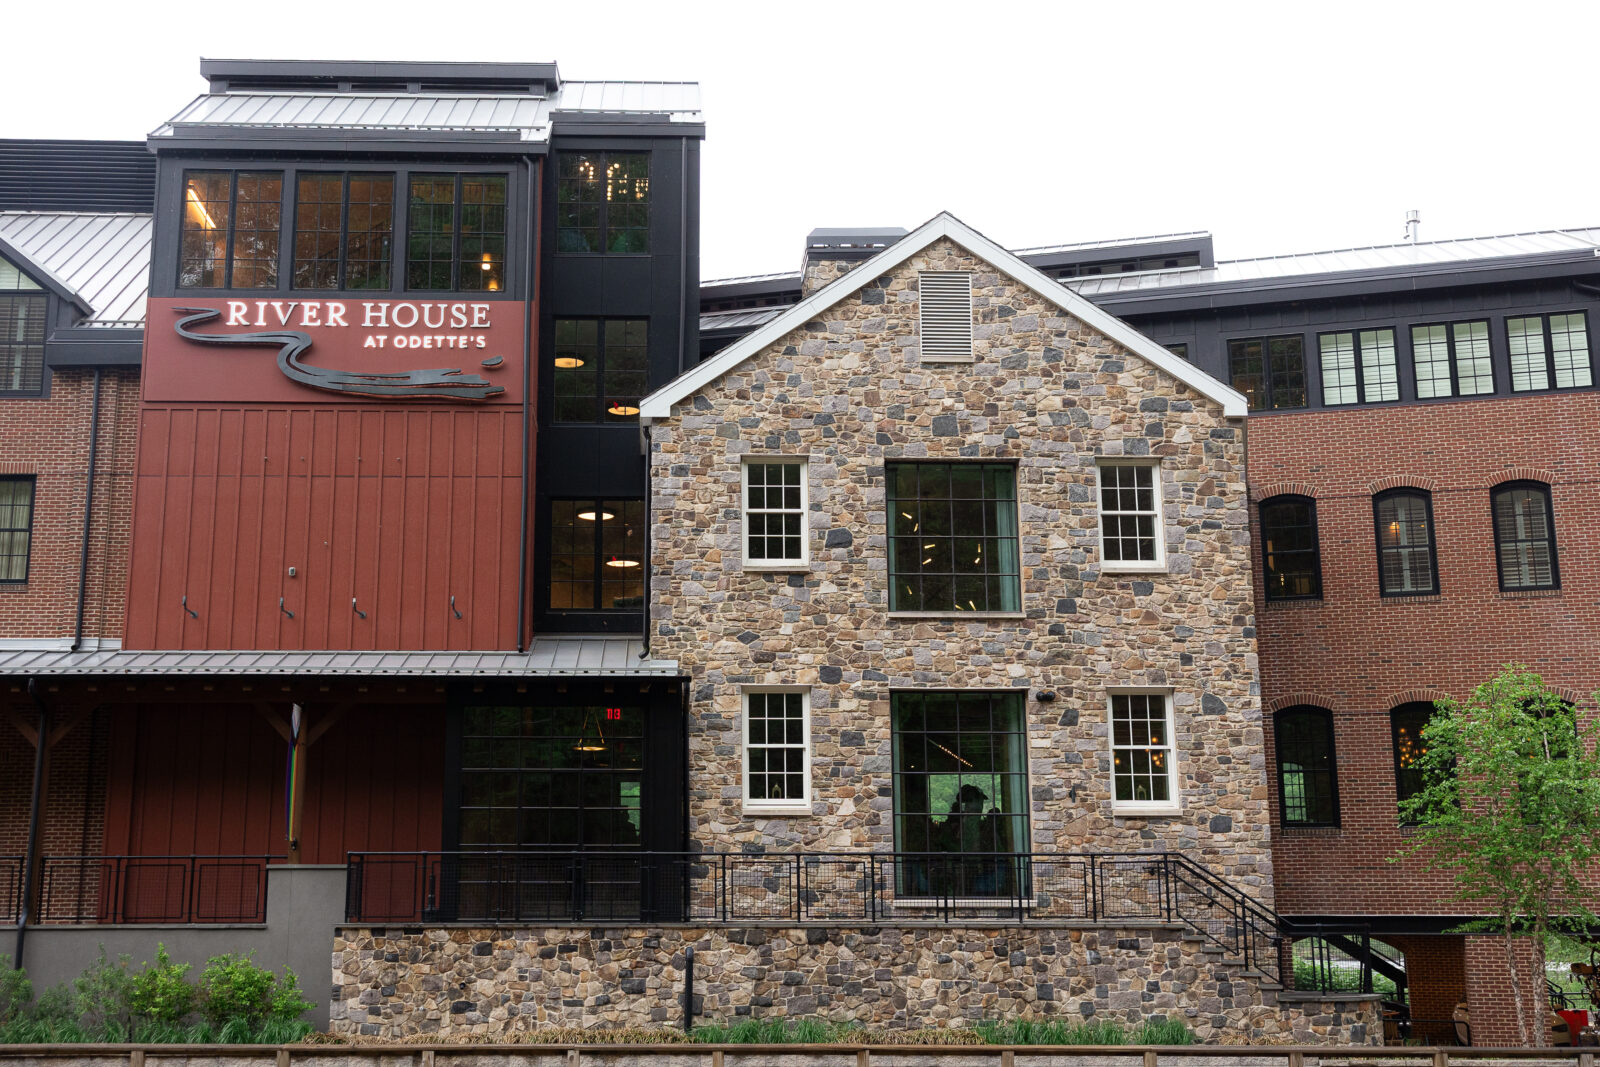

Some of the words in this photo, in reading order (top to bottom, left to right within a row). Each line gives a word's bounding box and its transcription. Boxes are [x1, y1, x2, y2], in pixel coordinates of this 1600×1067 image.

[226, 301, 349, 327] RIVER
[362, 302, 491, 328] HOUSE
[363, 335, 387, 348] AT
[393, 335, 486, 349] ODETTE'S
